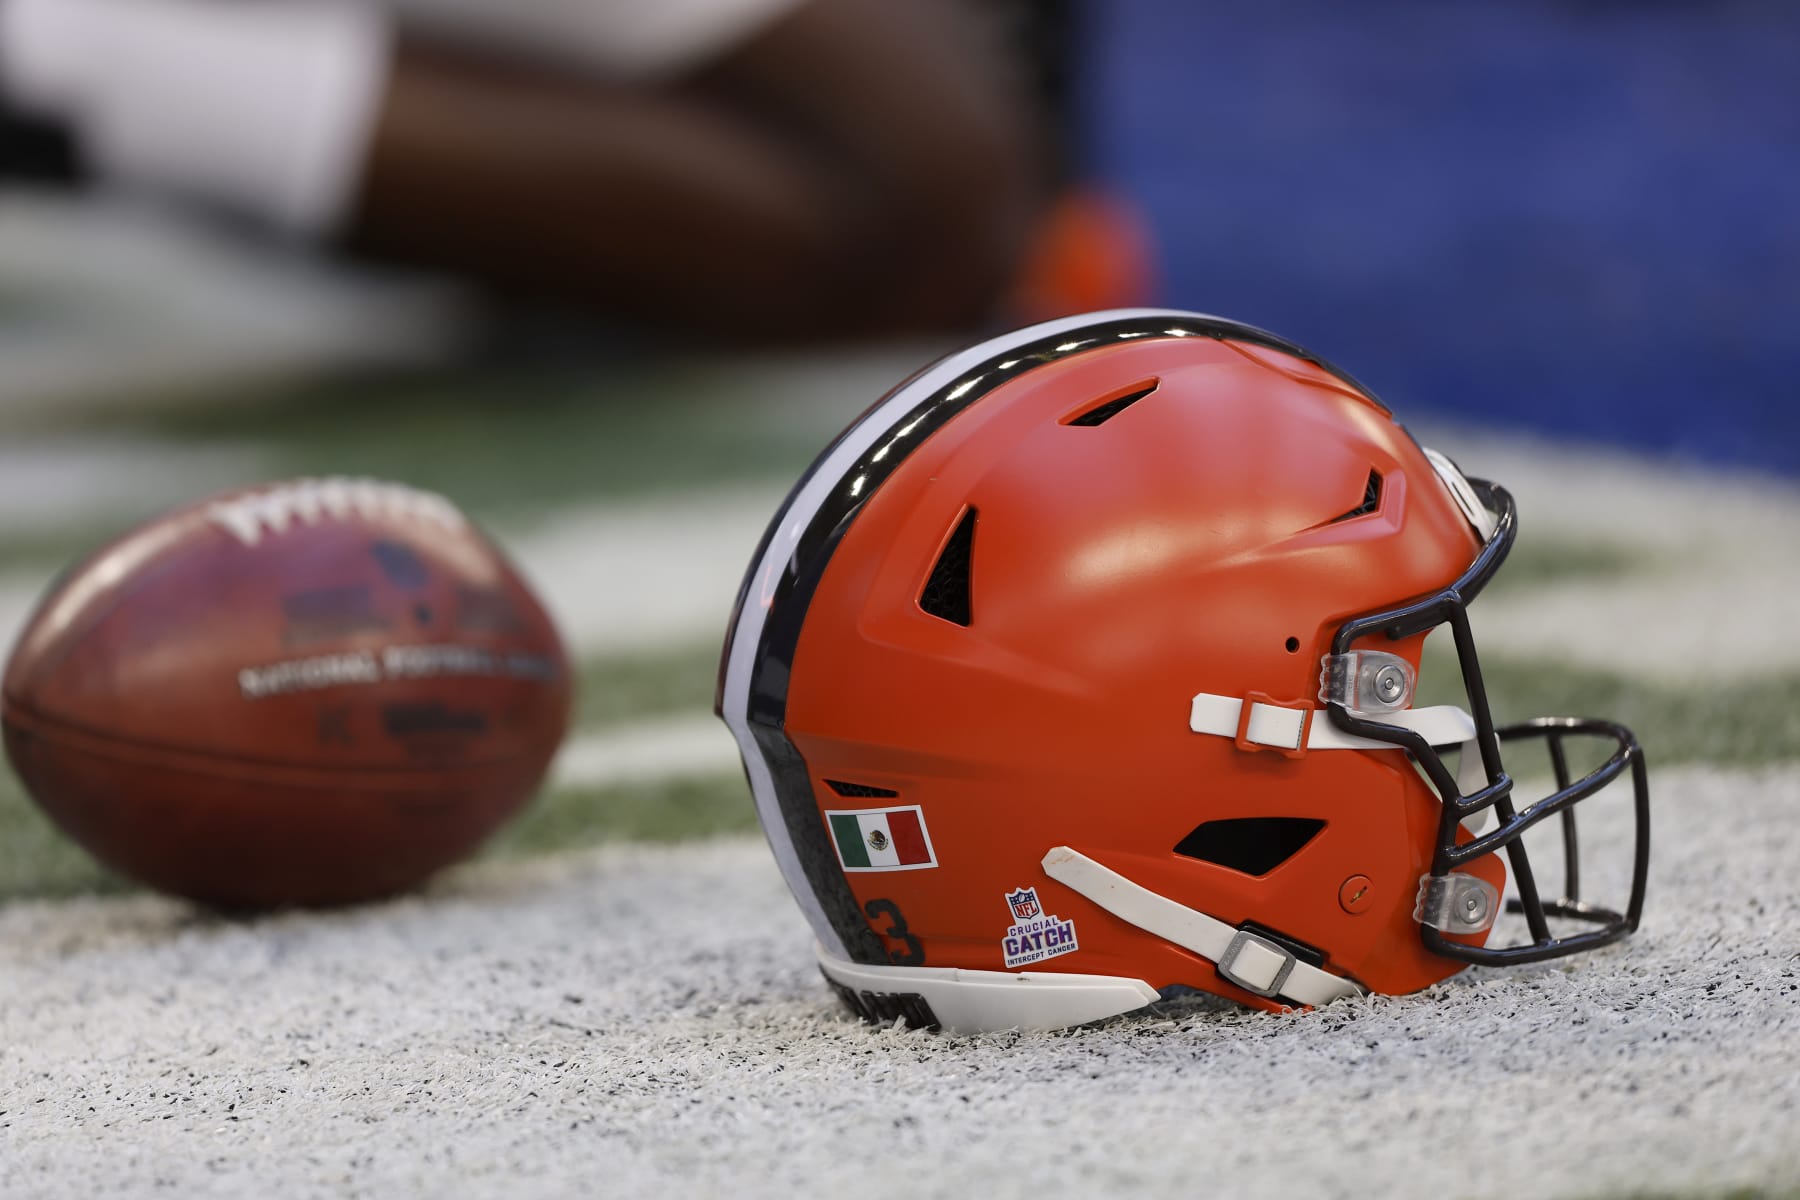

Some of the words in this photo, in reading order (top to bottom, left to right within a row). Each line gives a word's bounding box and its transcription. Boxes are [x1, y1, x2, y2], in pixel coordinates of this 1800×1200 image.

[1015, 902, 1037, 917] NFL
[1010, 917, 1058, 937] CRUCIAL
[1005, 923, 1073, 956] CATCH
[1007, 951, 1044, 966] INTERCEPT
[1047, 943, 1076, 956] CANCER
